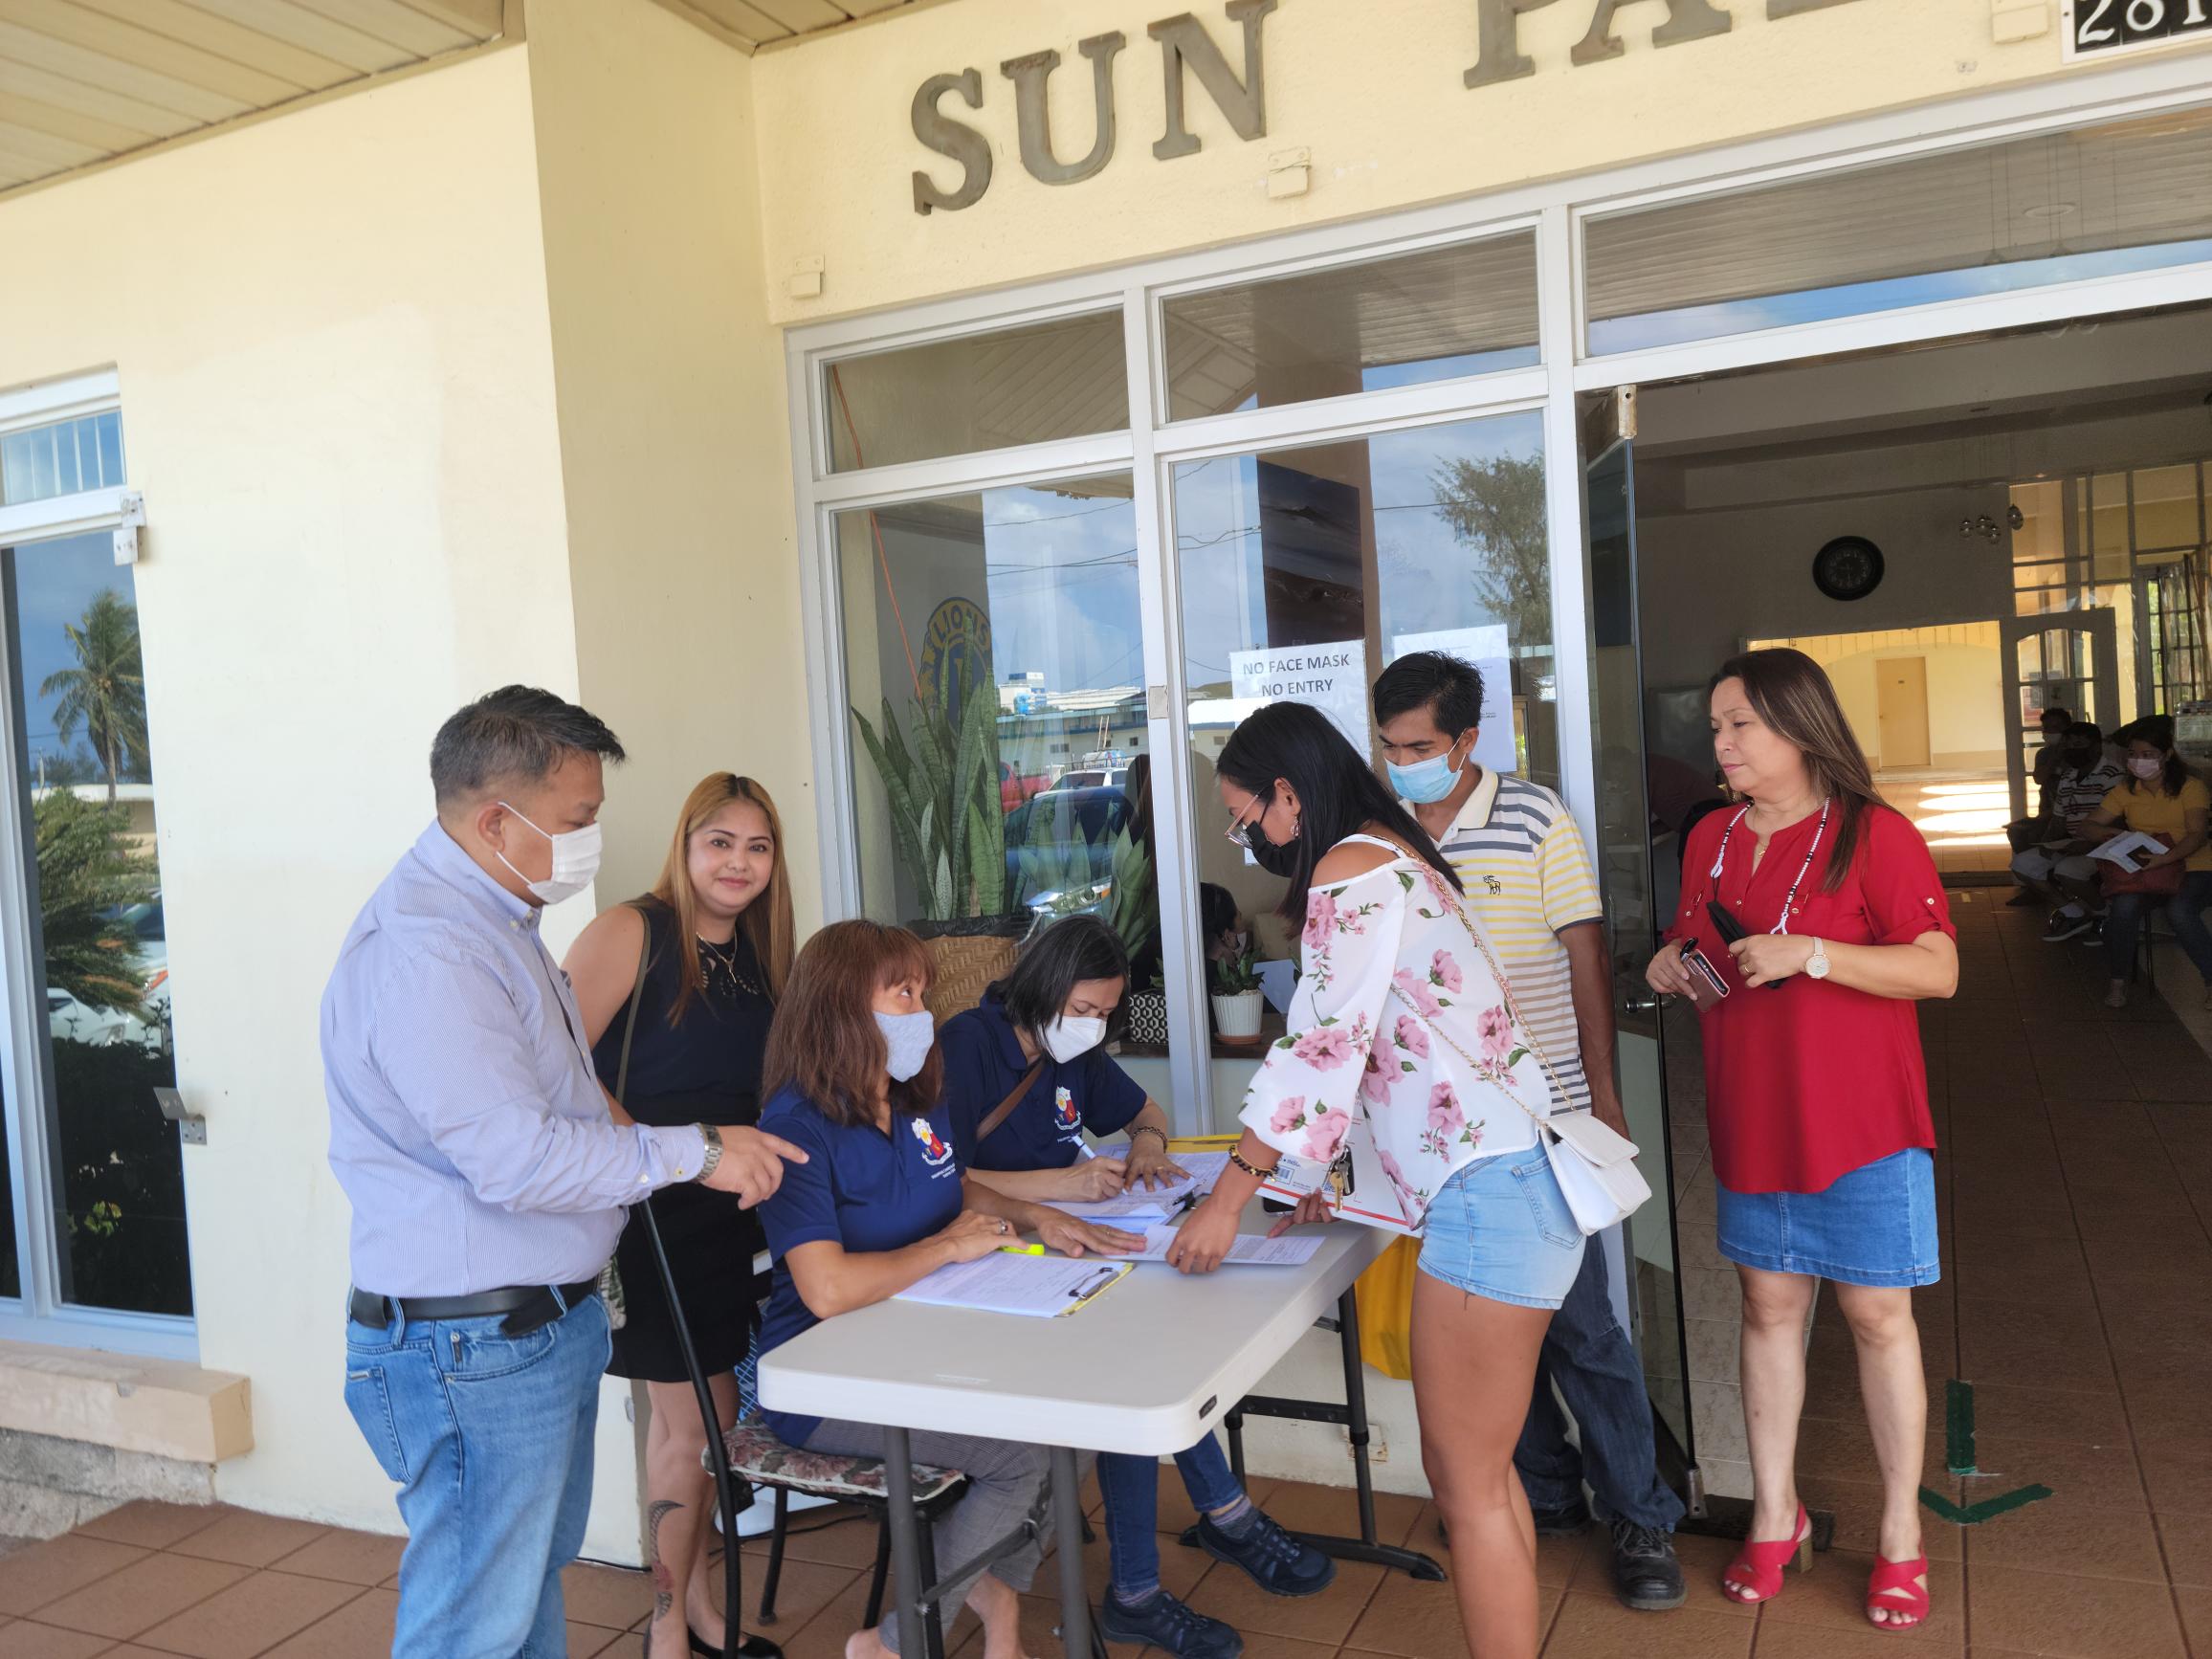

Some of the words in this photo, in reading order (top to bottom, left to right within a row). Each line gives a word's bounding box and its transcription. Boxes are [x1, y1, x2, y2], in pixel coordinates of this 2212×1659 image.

[911, 0, 1277, 215] SUN
[1243, 661, 1264, 675] NO
[1269, 657, 1303, 674] FACE
[1307, 653, 1351, 670] MASK
[1262, 683, 1284, 697] NO
[1288, 678, 1334, 695] ENTRY
